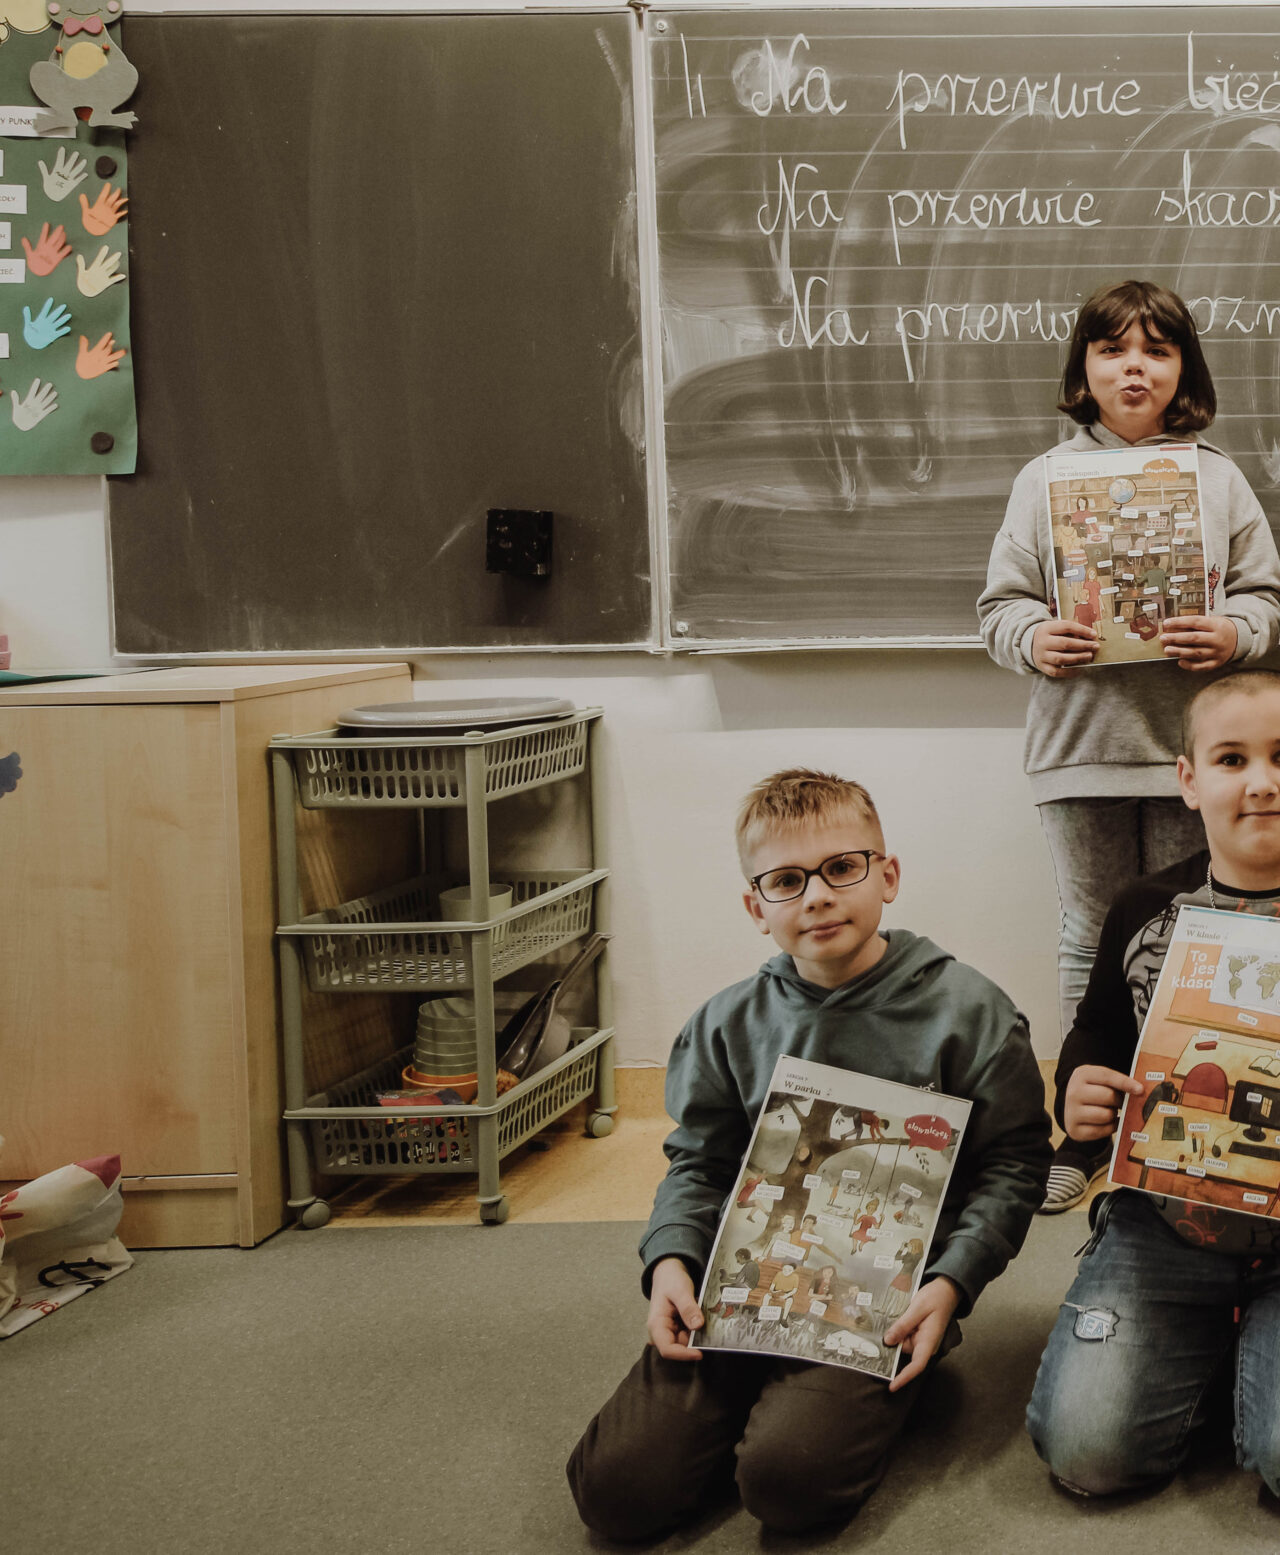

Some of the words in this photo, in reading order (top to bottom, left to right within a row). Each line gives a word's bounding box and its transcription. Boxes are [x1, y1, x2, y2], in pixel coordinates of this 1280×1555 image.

[751, 33, 847, 117] Na
[887, 56, 1141, 149] przerwie
[758, 158, 843, 235] Na
[888, 180, 1102, 265] przerwie
[778, 271, 870, 350] Na
[1190, 950, 1209, 963] To
[1191, 962, 1222, 977] jest
[784, 1080, 794, 1089] W
[794, 1082, 822, 1097] parku
